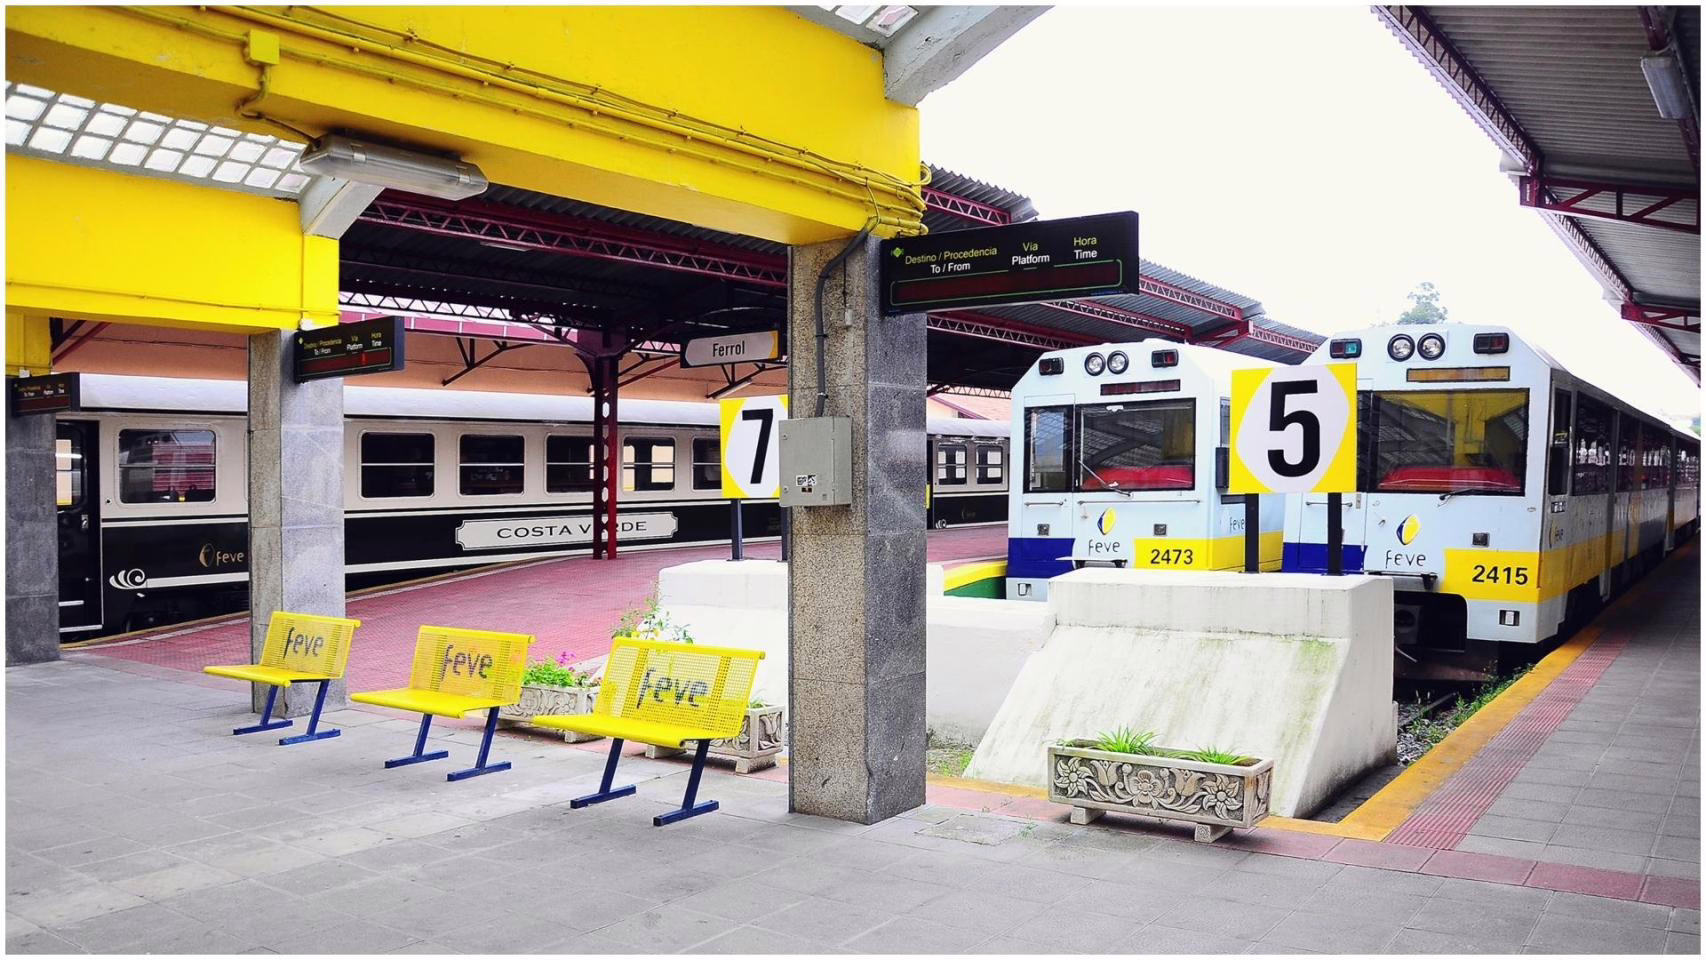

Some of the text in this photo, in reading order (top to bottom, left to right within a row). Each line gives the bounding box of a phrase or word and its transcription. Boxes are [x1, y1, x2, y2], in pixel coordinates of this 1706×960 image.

[1073, 236, 1097, 247] Hora
[905, 254, 937, 265] Destino
[943, 247, 998, 260] Procedencia
[1011, 254, 1051, 266] Platform
[1073, 249, 1098, 260] Time
[930, 264, 941, 274] To
[947, 262, 971, 272] From
[712, 340, 745, 357] Ferrol
[1267, 379, 1320, 478] 5
[741, 408, 774, 484] 7
[496, 521, 647, 539] COSTA VDE
[1088, 539, 1121, 556] feve
[1150, 548, 1194, 565] 2473
[215, 551, 245, 567] feve
[1385, 549, 1427, 569] feve
[1472, 564, 1529, 585] 2415
[283, 626, 324, 660] feve
[440, 644, 493, 682] feve
[636, 666, 709, 709] feve
